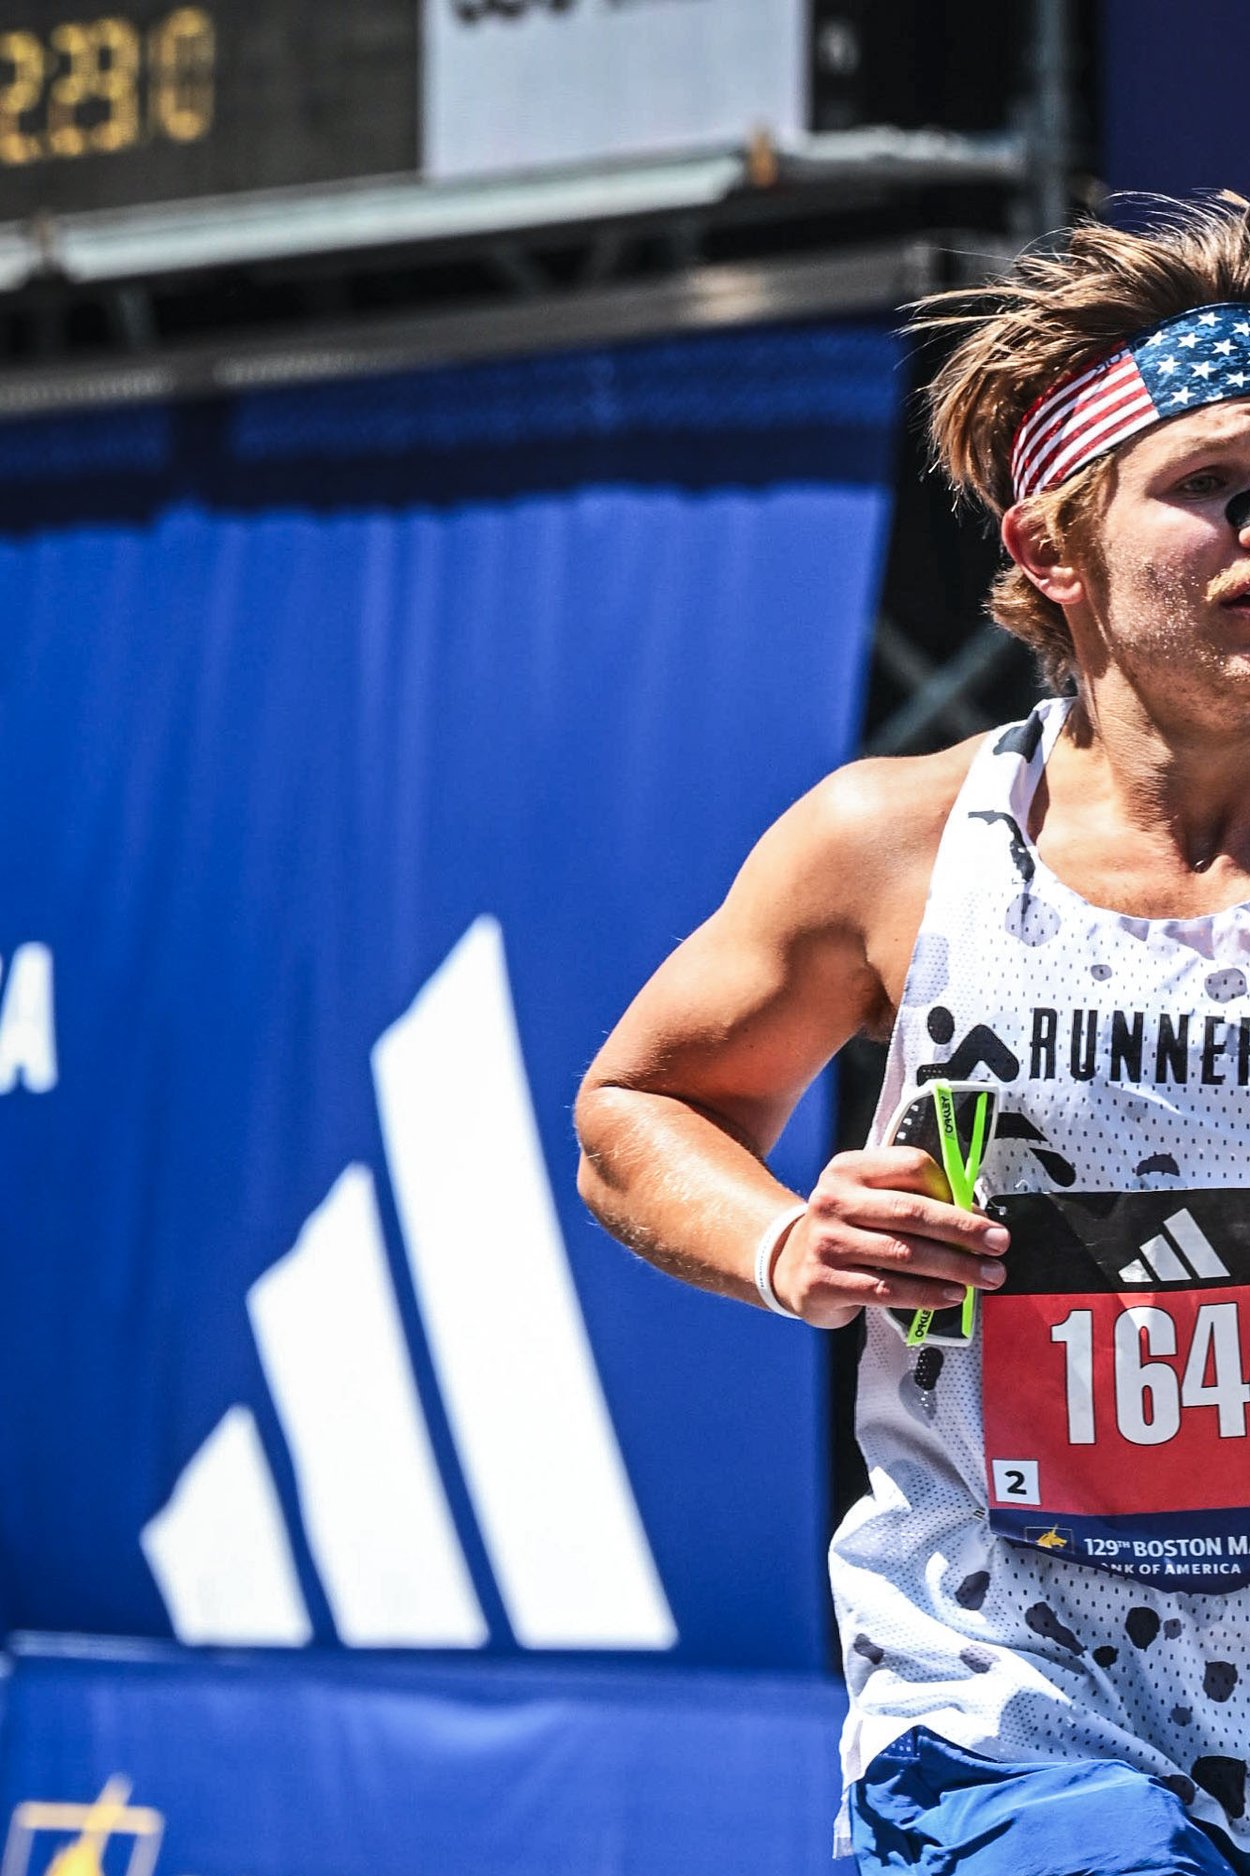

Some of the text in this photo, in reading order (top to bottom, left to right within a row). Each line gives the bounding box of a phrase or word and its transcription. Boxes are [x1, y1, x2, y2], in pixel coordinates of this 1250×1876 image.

[1005, 1470, 1027, 1495] 2
[1084, 1538, 1131, 1556] 129TH
[1134, 1538, 1222, 1557] BOSTON
[1101, 1563, 1241, 1575] NK OF AMERICA
